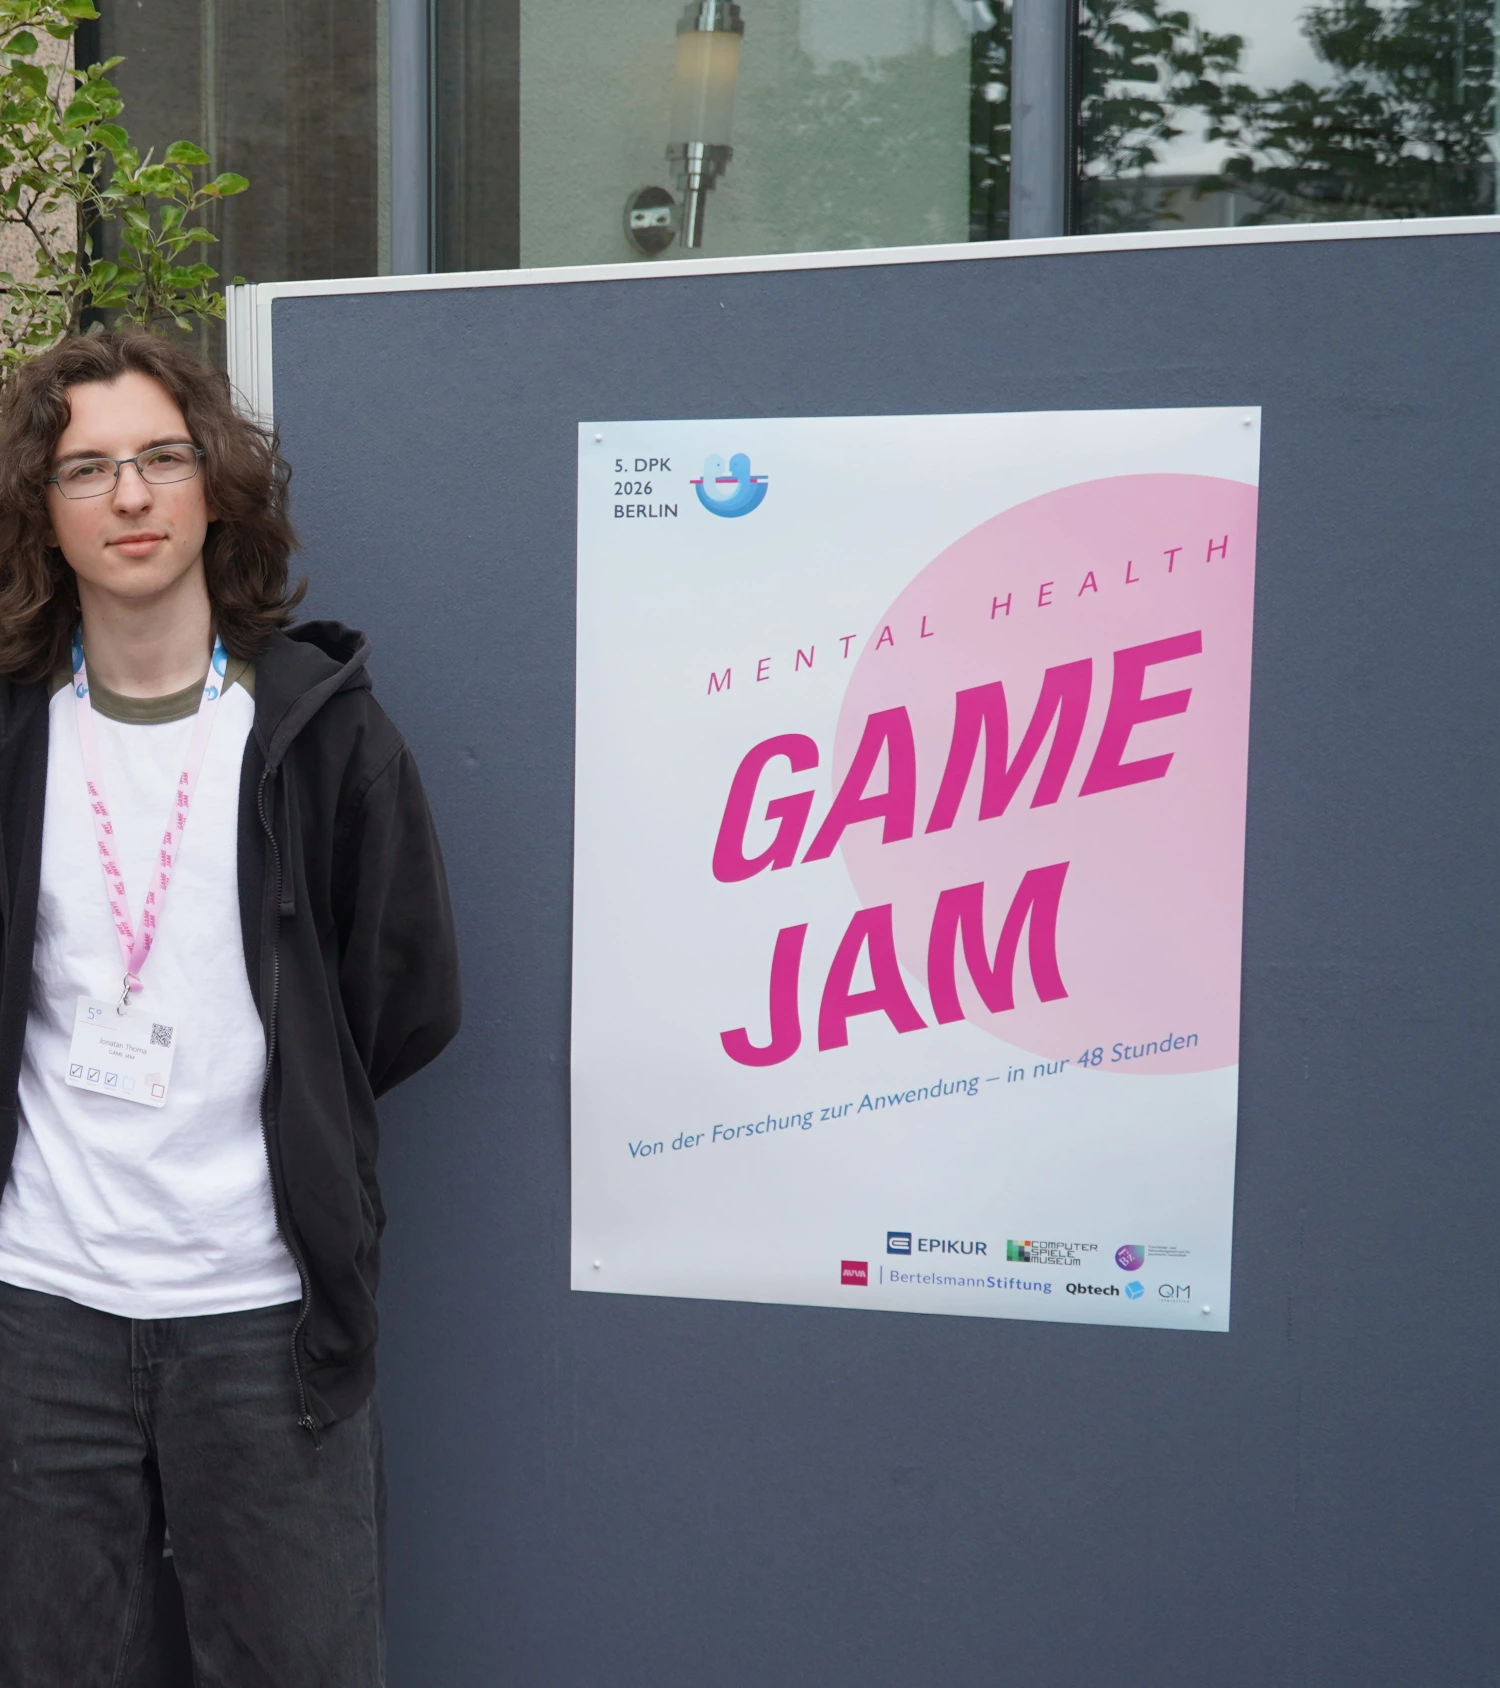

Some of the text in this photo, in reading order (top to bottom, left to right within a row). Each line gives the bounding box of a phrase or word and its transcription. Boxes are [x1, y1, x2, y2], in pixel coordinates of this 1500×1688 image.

[614, 457, 672, 473] 5. DPK
[614, 481, 653, 496] 2026
[613, 503, 678, 519] BERLIN
[706, 534, 1229, 695] MENTAL HEALTH
[712, 630, 1202, 882] GAME
[720, 861, 1070, 1067] JAM
[627, 1140, 664, 1159] Von
[671, 1131, 705, 1151] der
[712, 1111, 814, 1143] Forschung
[819, 1102, 854, 1121] zur
[857, 1076, 980, 1114] Anwendung
[1007, 1065, 1025, 1083] in
[1033, 1058, 1071, 1078] nur
[1076, 1046, 1105, 1069] 48
[1111, 1032, 1199, 1063] Stunden
[918, 1238, 1098, 1256] EPIKUR COMPUTER
[1030, 1248, 1076, 1258] SPIELE
[1030, 1256, 1081, 1267] MUSEUM
[1065, 1283, 1120, 1297] Qbtech
[1158, 1283, 1191, 1299] QM
